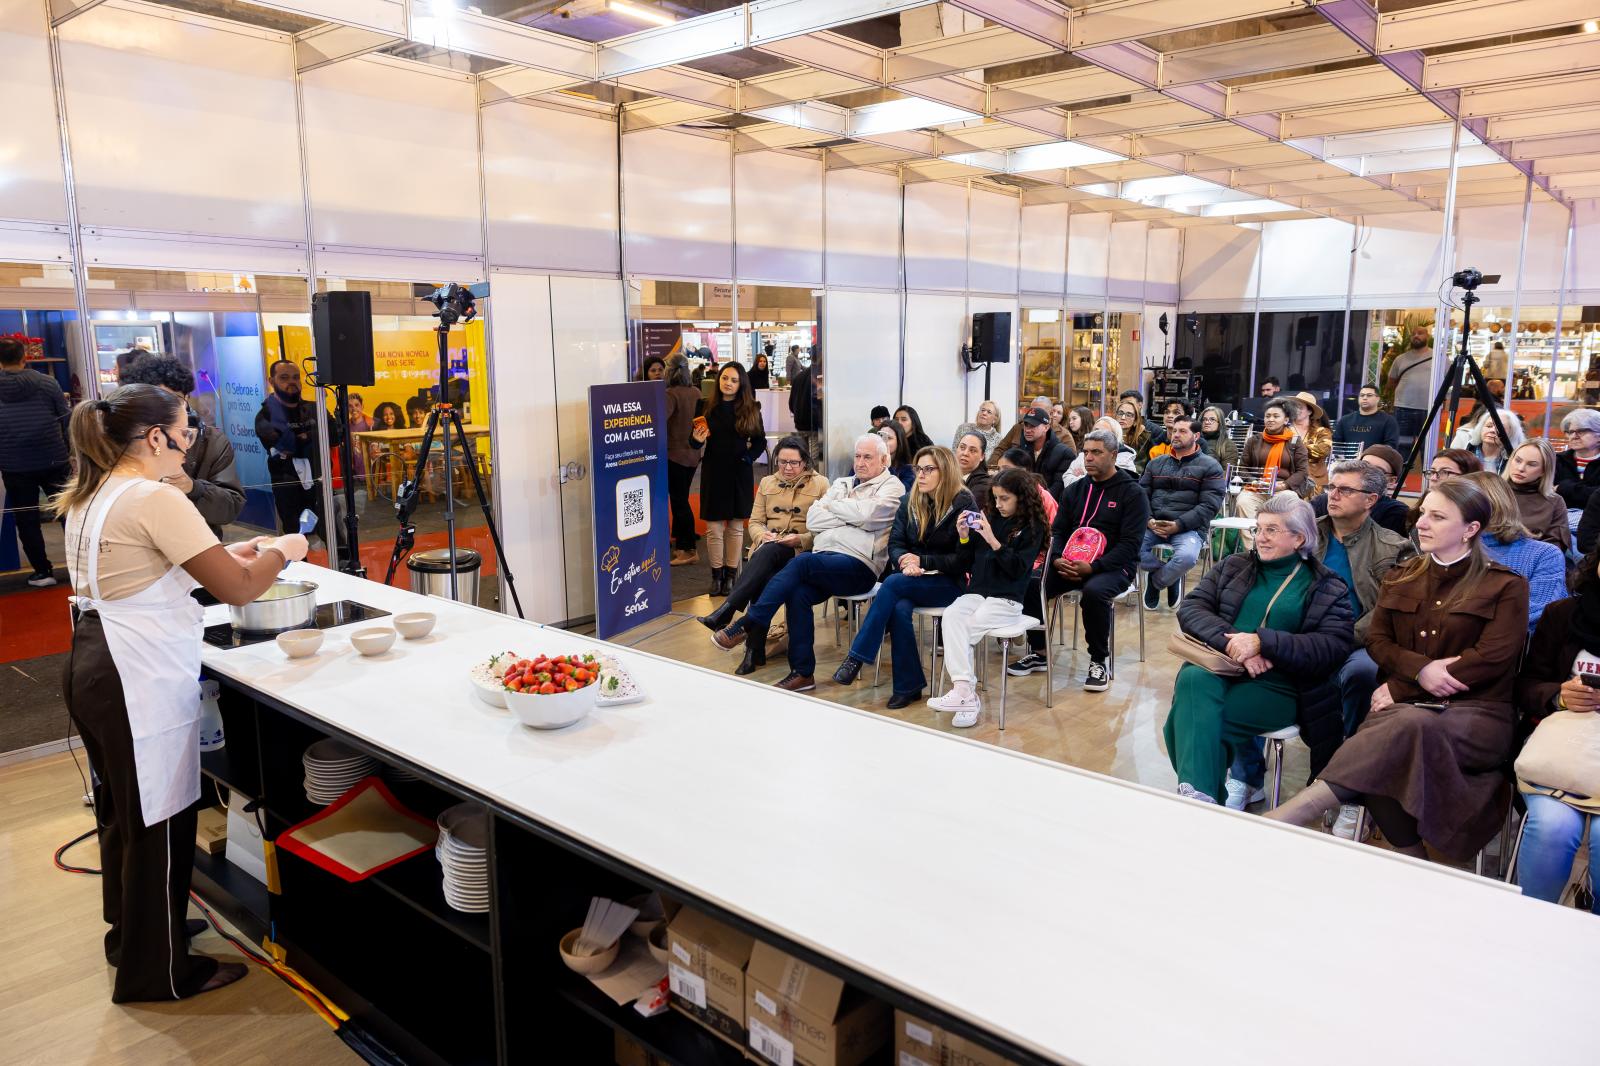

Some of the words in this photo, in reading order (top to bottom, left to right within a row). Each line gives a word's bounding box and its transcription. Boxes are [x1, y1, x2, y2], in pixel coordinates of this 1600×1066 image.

[405, 350, 430, 358] NOVELA
[399, 359, 416, 367] SETE
[226, 382, 231, 394] O
[231, 382, 254, 396] Sebrae
[254, 383, 259, 396] é
[603, 404, 621, 414] VIVA
[623, 402, 641, 412] ESSA
[604, 414, 652, 430] EXPERIÊNCIA
[236, 424, 256, 438] Sebra
[604, 433, 622, 444] COM
[624, 432, 629, 441] A
[630, 428, 655, 439] GENTE.
[604, 453, 615, 461] Faça
[604, 461, 618, 469] Arena
[611, 568, 623, 594] Eu
[623, 562, 641, 584] estive
